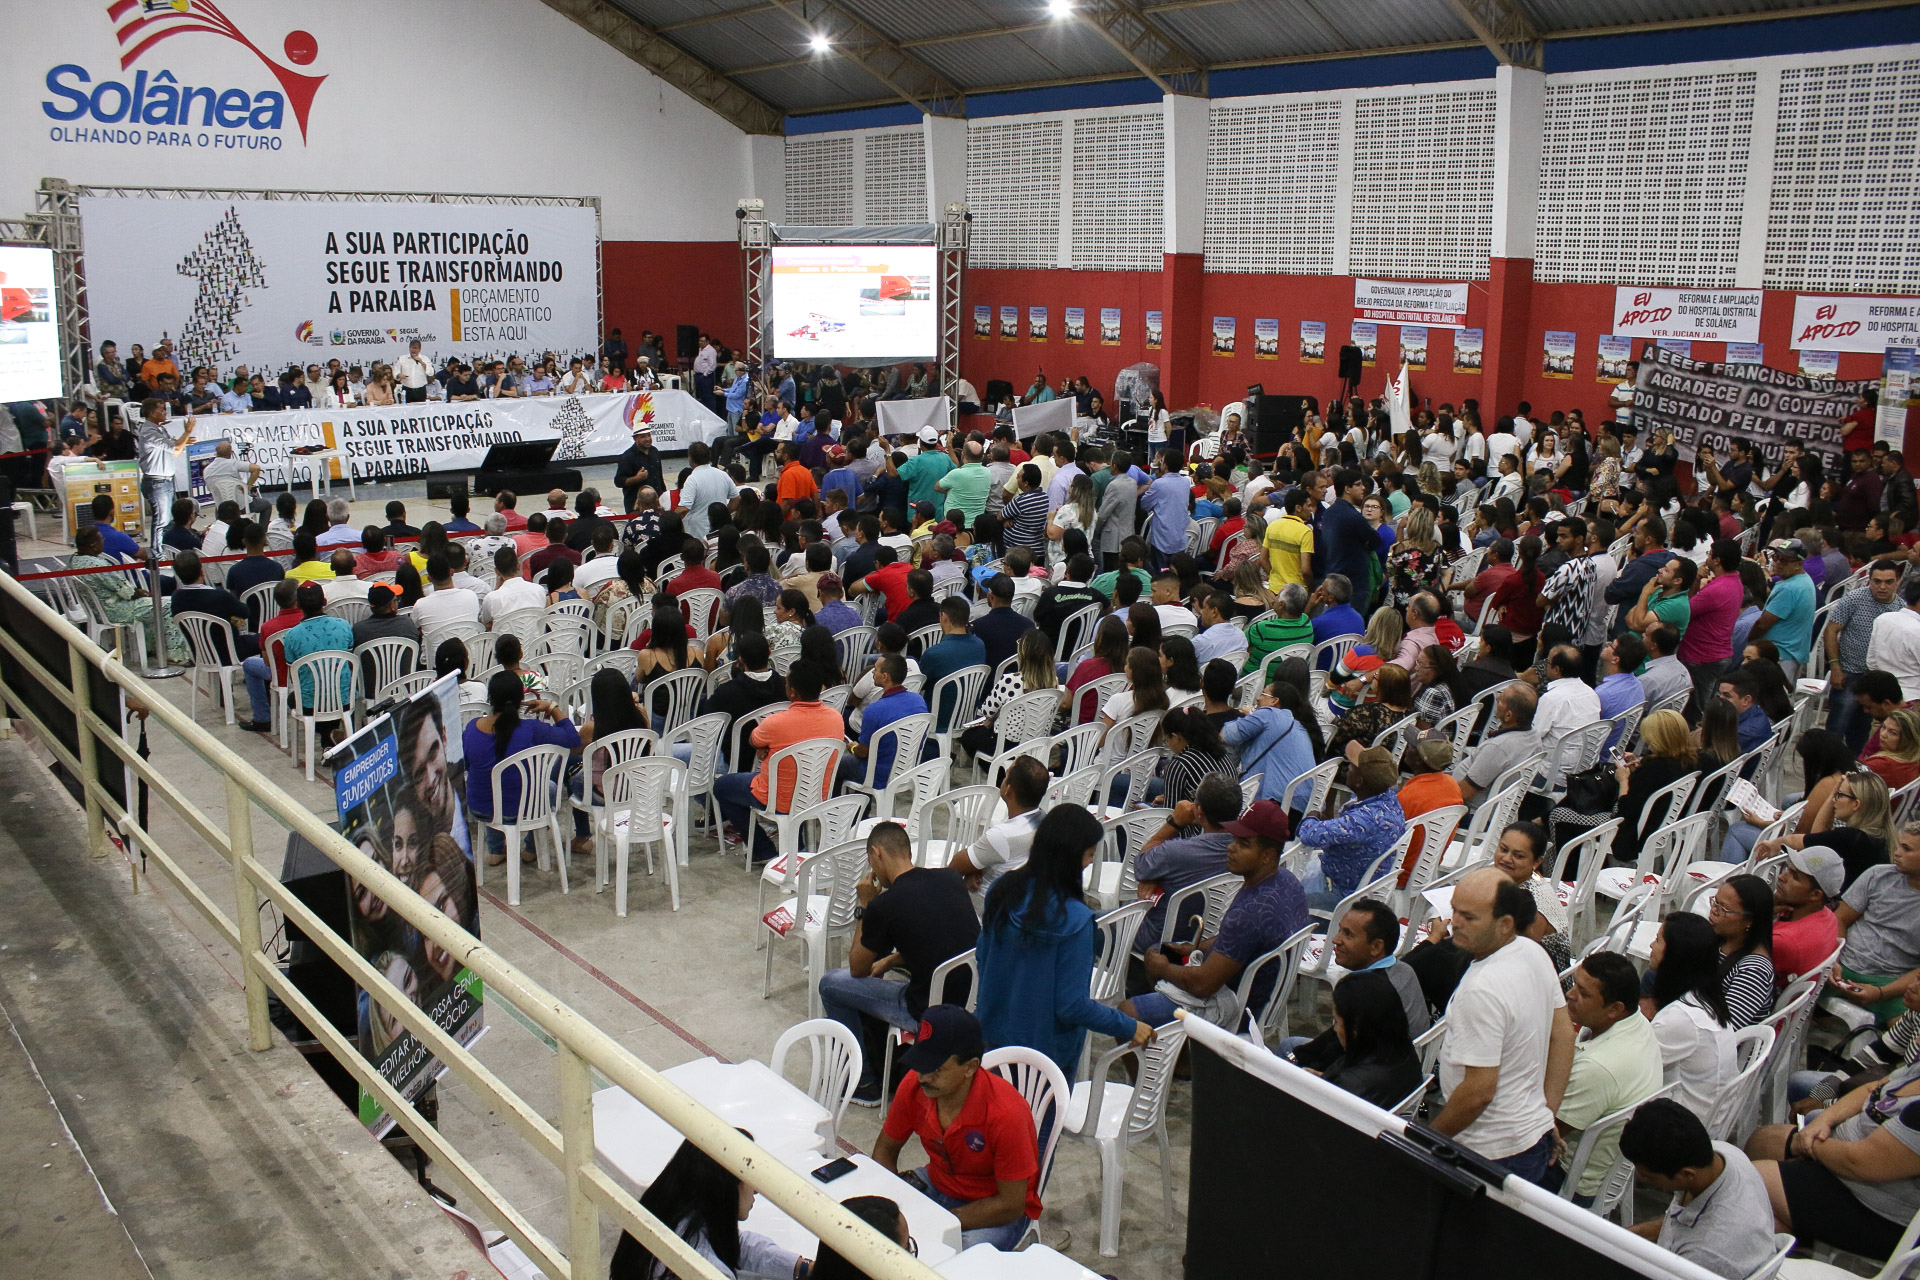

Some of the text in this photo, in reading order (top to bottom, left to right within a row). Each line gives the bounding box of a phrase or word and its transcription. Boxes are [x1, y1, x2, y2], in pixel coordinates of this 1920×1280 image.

[41, 63, 285, 131] Solânea
[50, 127, 283, 151] OLHANDO PARA O FUTURO
[325, 228, 529, 260] A SUA PARTICIPAÇÃO
[326, 260, 563, 284] SEGUE TRANSFORMANDO
[328, 284, 437, 314] A PARAÍBA
[462, 288, 540, 307] ORÇAMENTO
[1412, 287, 1443, 298] POPULAÇÃO
[1444, 290, 1451, 298] DO
[1633, 292, 1652, 307] EU
[1679, 293, 1759, 307] REFORMA E AMPLIAÇÃO
[463, 300, 552, 323] DEMOCRÁTICO
[1356, 297, 1372, 306] BREJO
[1373, 298, 1394, 307] PRECISA
[1395, 299, 1403, 307] DA
[1404, 300, 1429, 309] REFORMA
[1434, 301, 1465, 312] AMPLIAÇÃO
[1678, 305, 1757, 318] DO HOSPITAL DISTRITAL
[1816, 304, 1837, 320] EU
[1868, 305, 1907, 317] REFORMA
[1909, 306, 1915, 317] E
[1363, 310, 1456, 323] DO HOSPITAL DISTRITAL DE SOLÂNEA
[1618, 307, 1672, 328] APOIO
[1695, 317, 1737, 329] DE SOLÂNEA
[347, 329, 380, 337] GOVERNO
[464, 326, 527, 342] ESTA AQUI
[1652, 329, 1669, 337] VER.
[1672, 330, 1700, 338] JUCIAN
[1797, 321, 1861, 343] APOIO
[1867, 321, 1919, 333] DO HOSPITAL
[347, 336, 386, 346] DA PARAÍBA
[1643, 346, 1654, 360] A
[1658, 348, 1707, 372] EEEF
[1712, 362, 1806, 389] FRANCISCO
[1650, 372, 1739, 403] AGRADECE
[1747, 391, 1770, 408] AO
[1634, 391, 1654, 409] DO
[1657, 396, 1723, 424] ESTADO
[1728, 412, 1776, 435] PELA
[1634, 415, 1644, 431] E
[343, 409, 493, 438] A SUA PARTICIPAÇÃO
[345, 430, 522, 458] SEGUE TRANSFORMANDO
[351, 454, 431, 479] A PARAÍBA
[344, 742, 389, 784] EMPREENDER
[341, 757, 394, 810] JUVENTUDES
